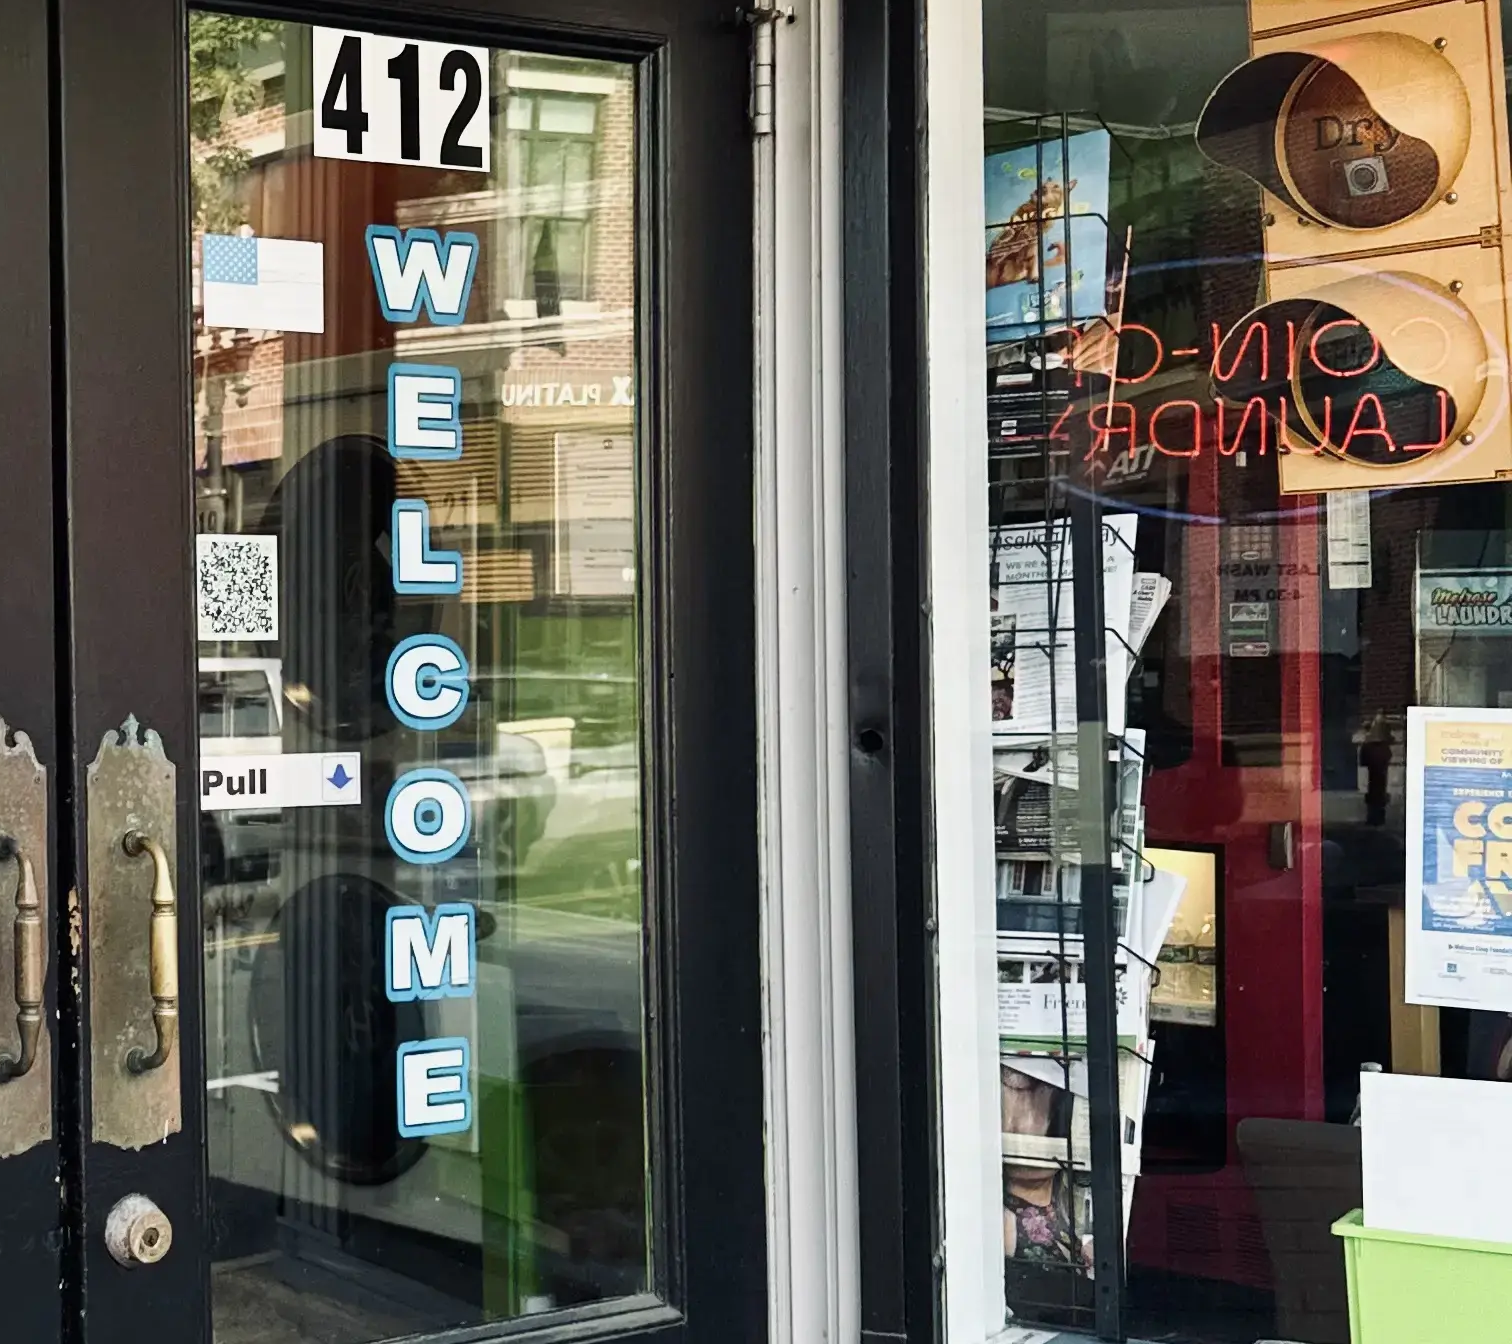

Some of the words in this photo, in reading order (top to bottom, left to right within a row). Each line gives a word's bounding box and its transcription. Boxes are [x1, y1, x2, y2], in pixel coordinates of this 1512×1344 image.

[321, 35, 484, 169] 412
[1311, 116, 1399, 153] Dry
[365, 224, 480, 1139] WELCOME
[201, 767, 268, 799] Pull
